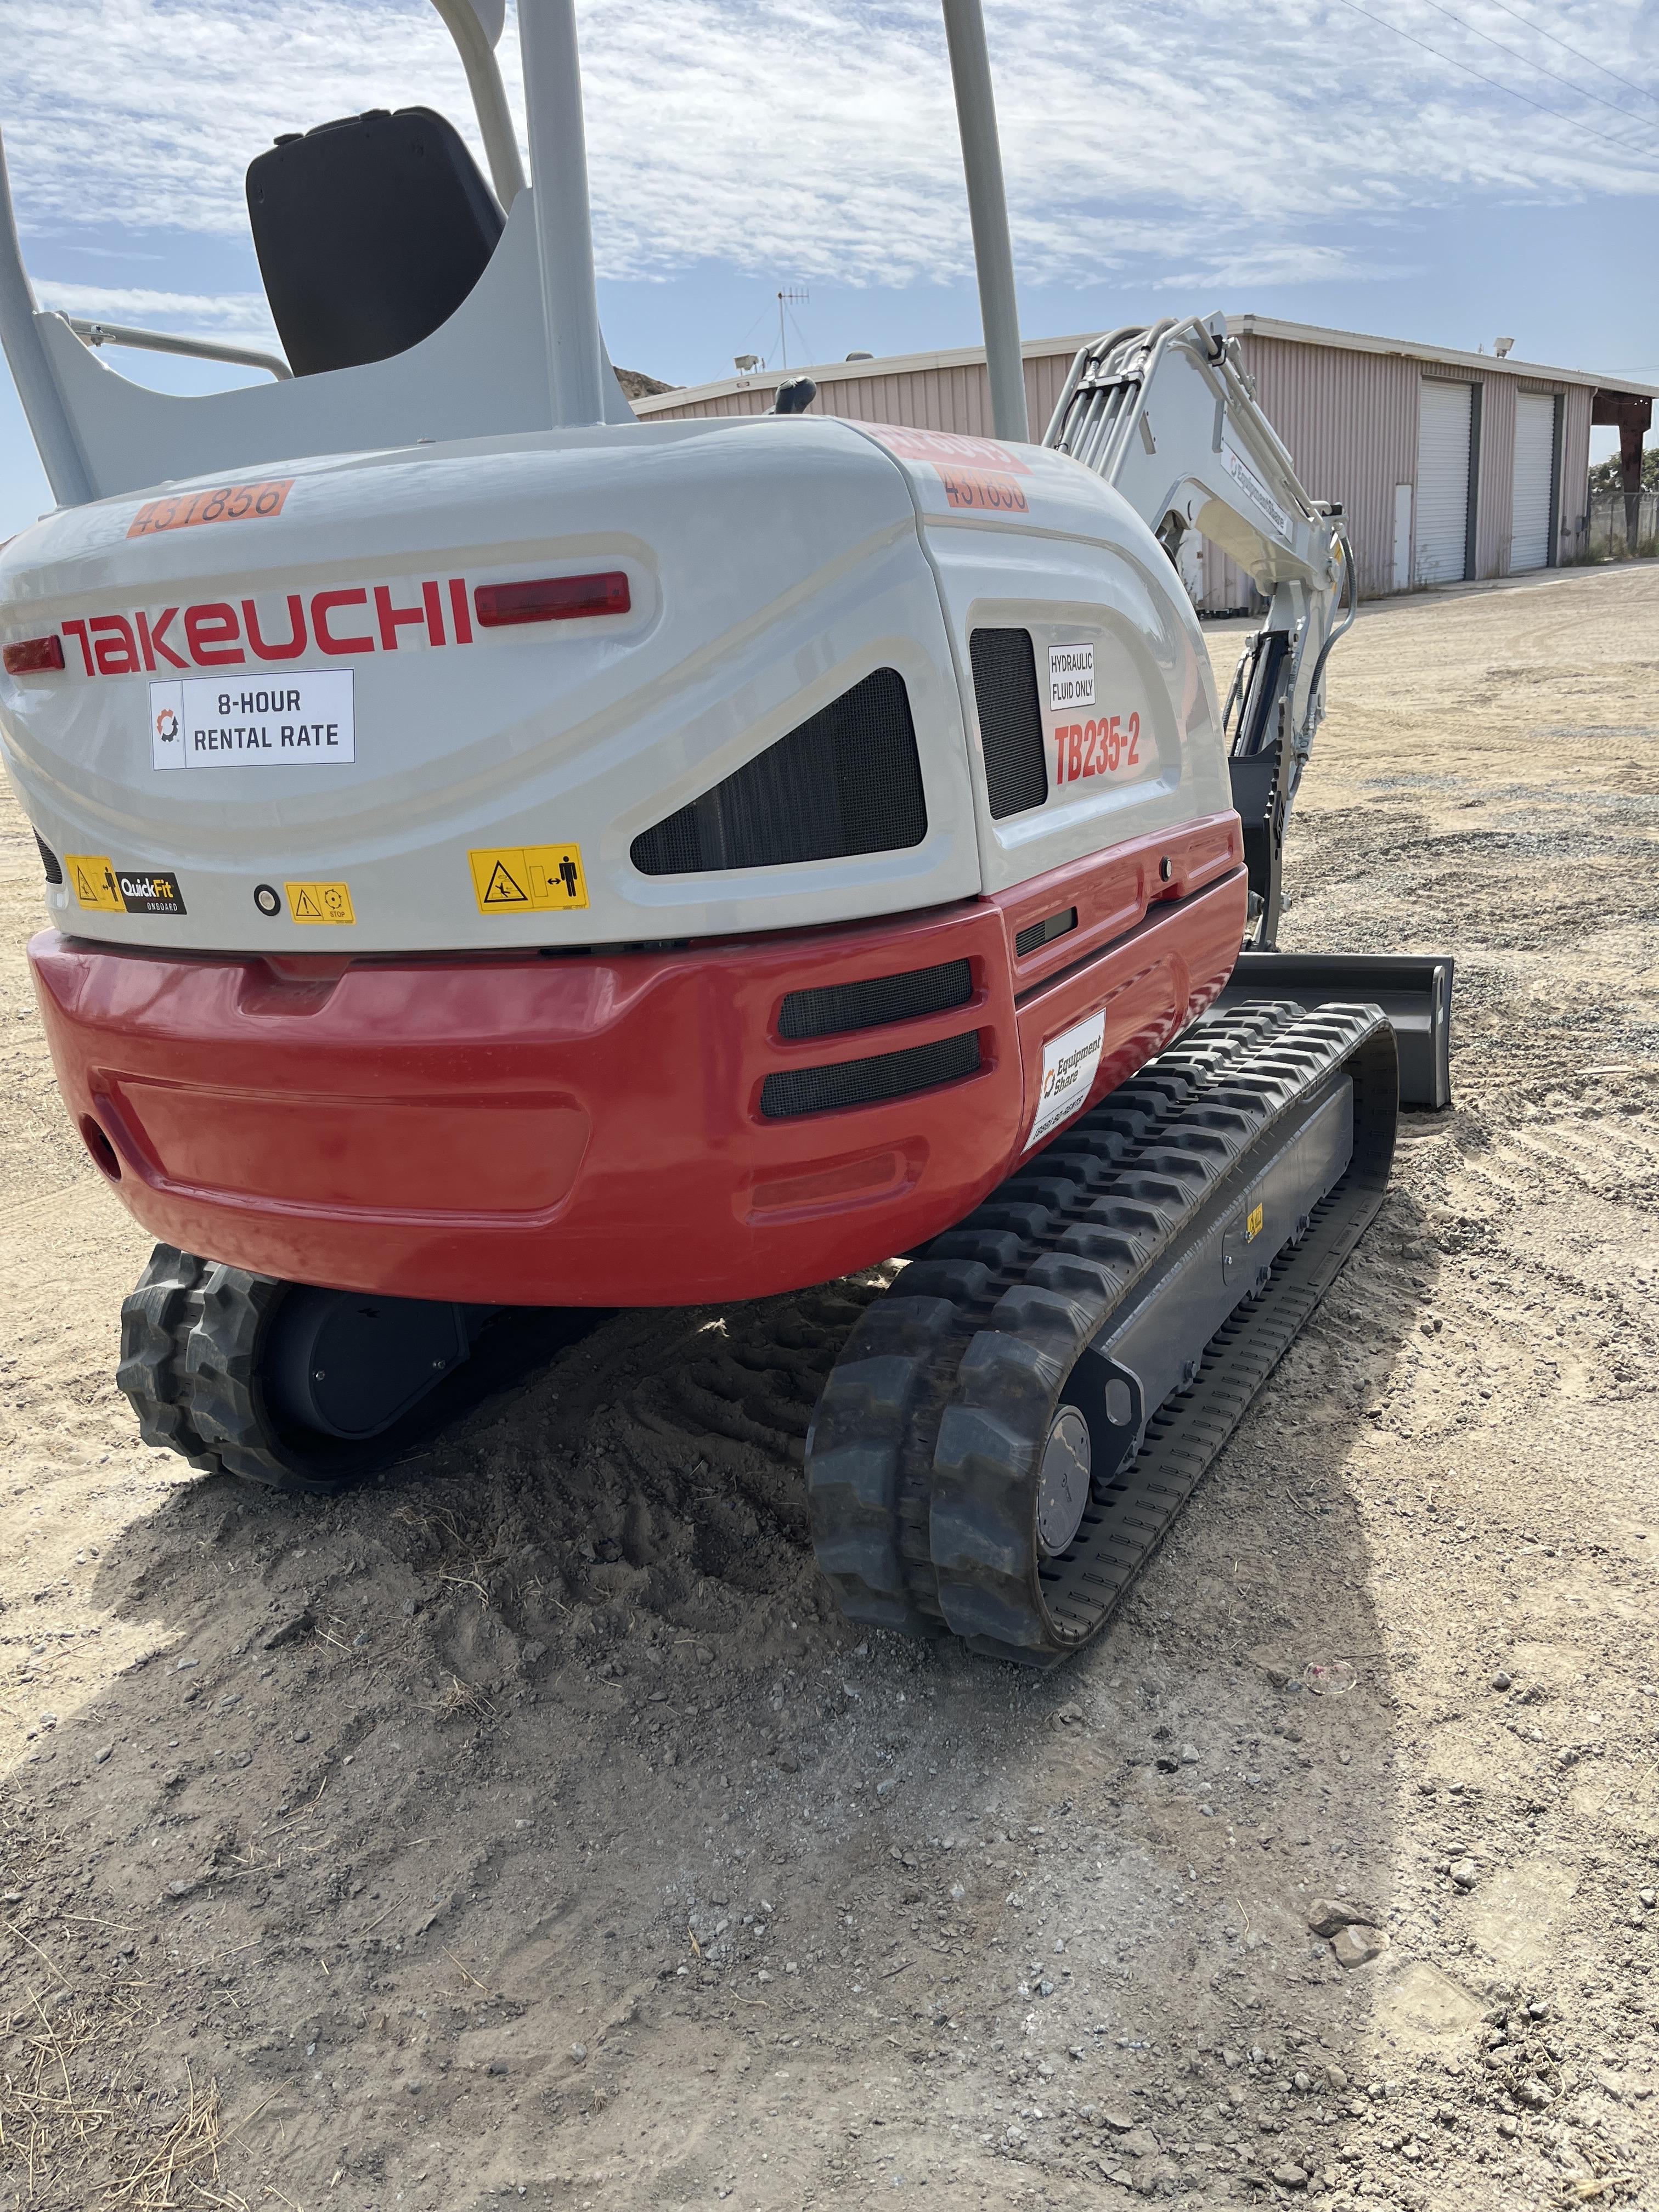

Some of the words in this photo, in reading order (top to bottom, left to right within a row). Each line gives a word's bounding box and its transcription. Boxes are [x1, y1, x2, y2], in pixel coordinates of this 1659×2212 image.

[134, 481, 286, 532] 431856
[1051, 652, 1093, 673] HYDRAULIC
[218, 689, 301, 715] 8-HOUR
[1052, 682, 1074, 701] FLUID
[1075, 679, 1093, 698] ONLY
[194, 726, 273, 751] RENTAL
[280, 723, 339, 747] RATE
[1054, 711, 1140, 785] TB235-2
[121, 878, 173, 898] QuickFit
[146, 902, 178, 911] ONBOARD
[1057, 1035, 1102, 1077] Equipment
[1053, 1069, 1078, 1096] Share
